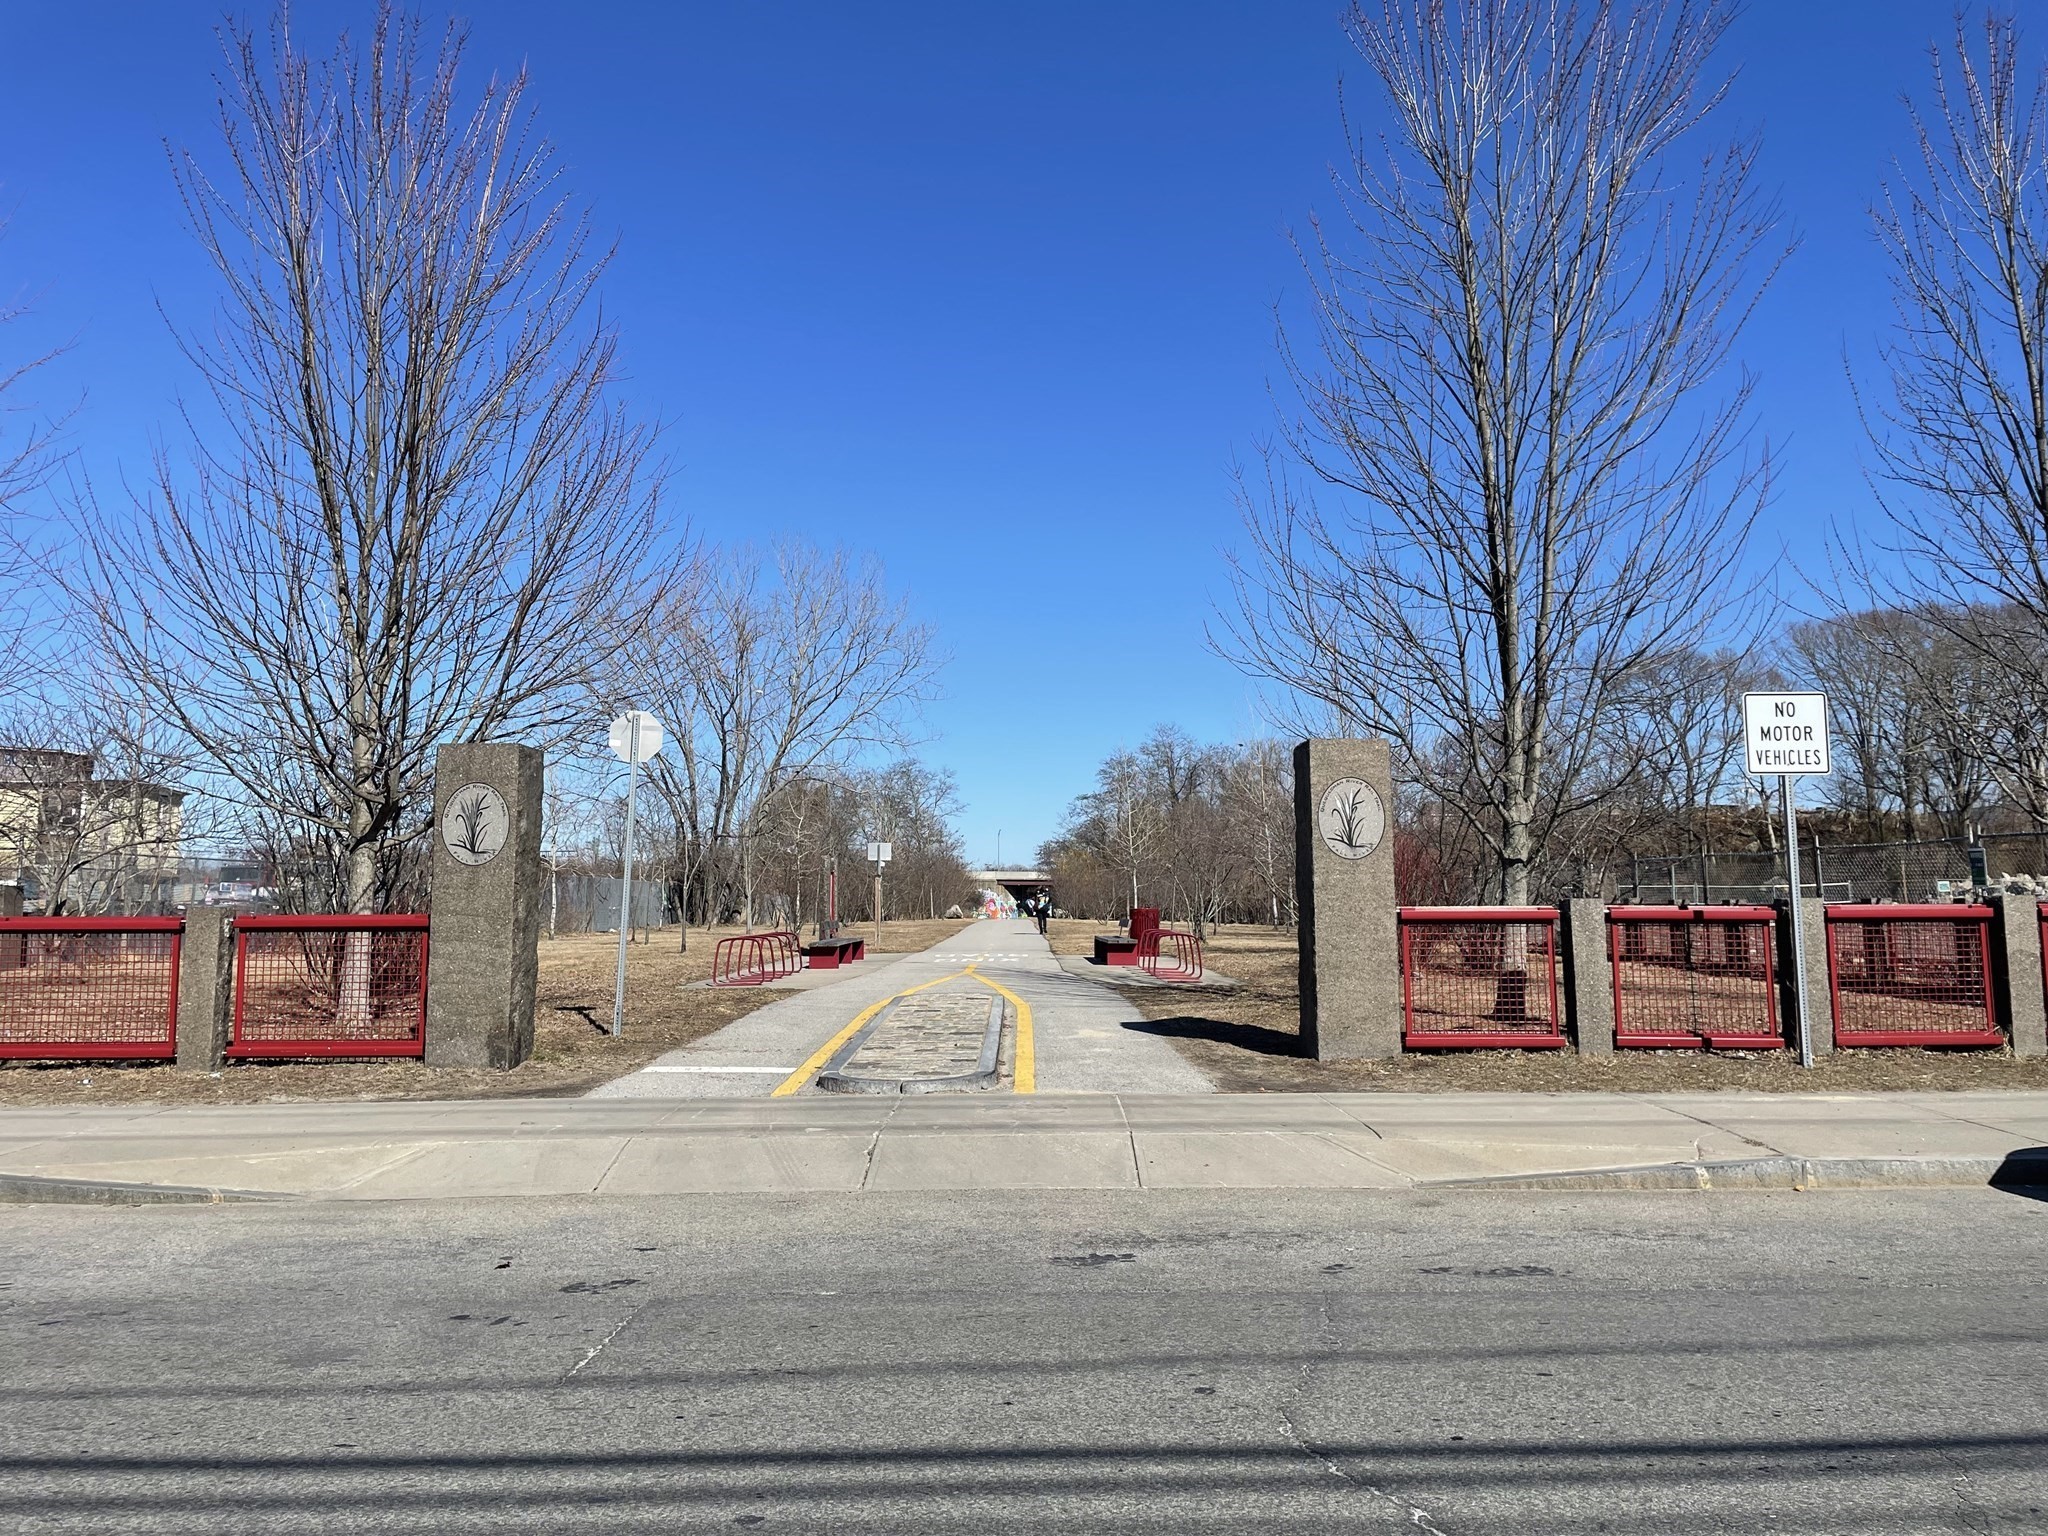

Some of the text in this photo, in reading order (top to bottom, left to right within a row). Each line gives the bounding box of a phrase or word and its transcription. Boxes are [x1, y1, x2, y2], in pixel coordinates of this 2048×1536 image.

[1775, 702, 1795, 717] NO
[1760, 726, 1813, 741] MOTOR
[1756, 749, 1821, 765] VEHICLES
